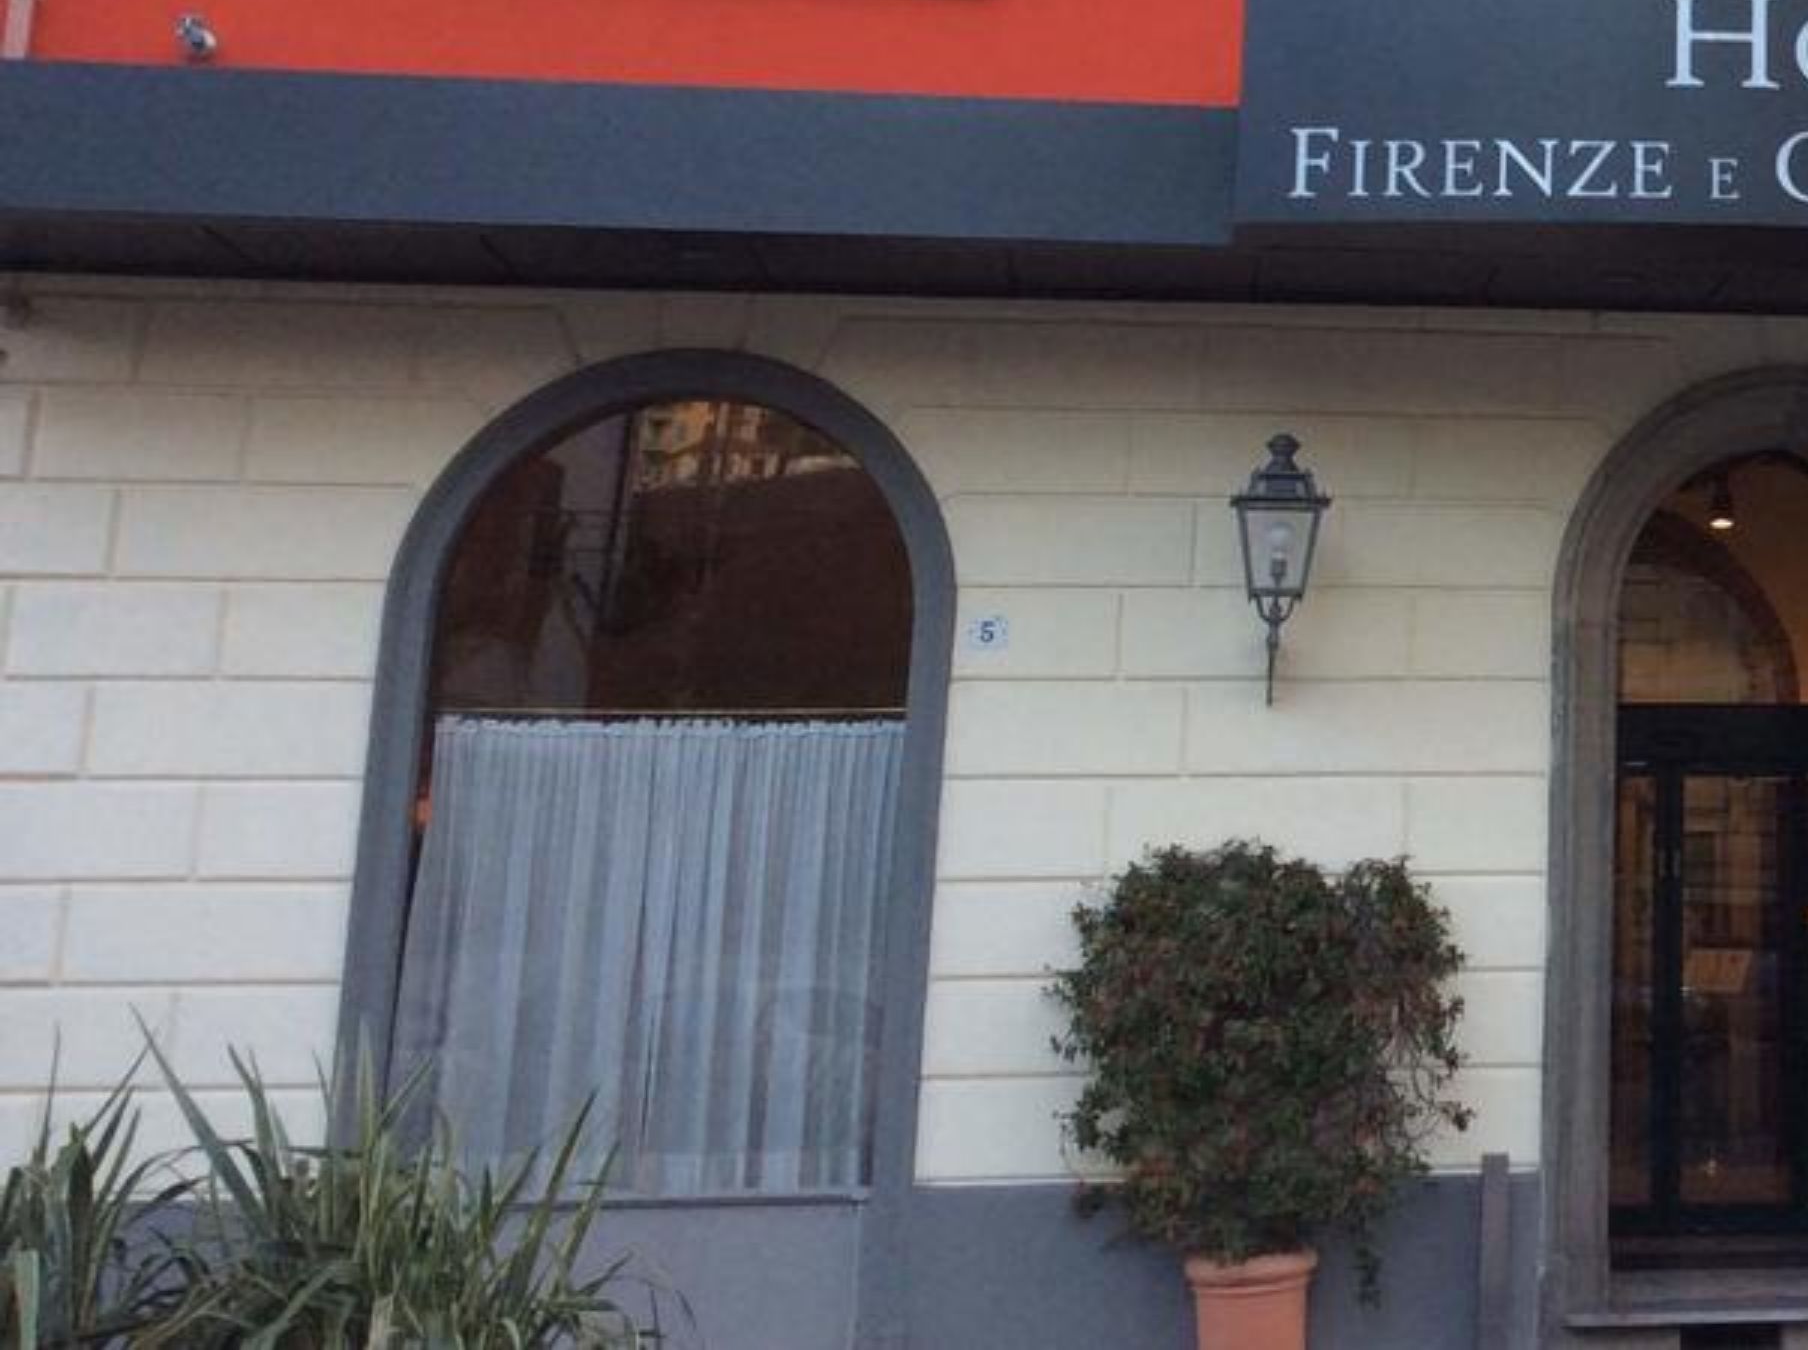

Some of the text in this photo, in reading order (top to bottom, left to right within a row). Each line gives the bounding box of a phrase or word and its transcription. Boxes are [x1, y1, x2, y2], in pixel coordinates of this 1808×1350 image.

[1287, 126, 1675, 202] FIRENZE
[1708, 156, 1741, 201] E
[980, 620, 995, 643] 5
